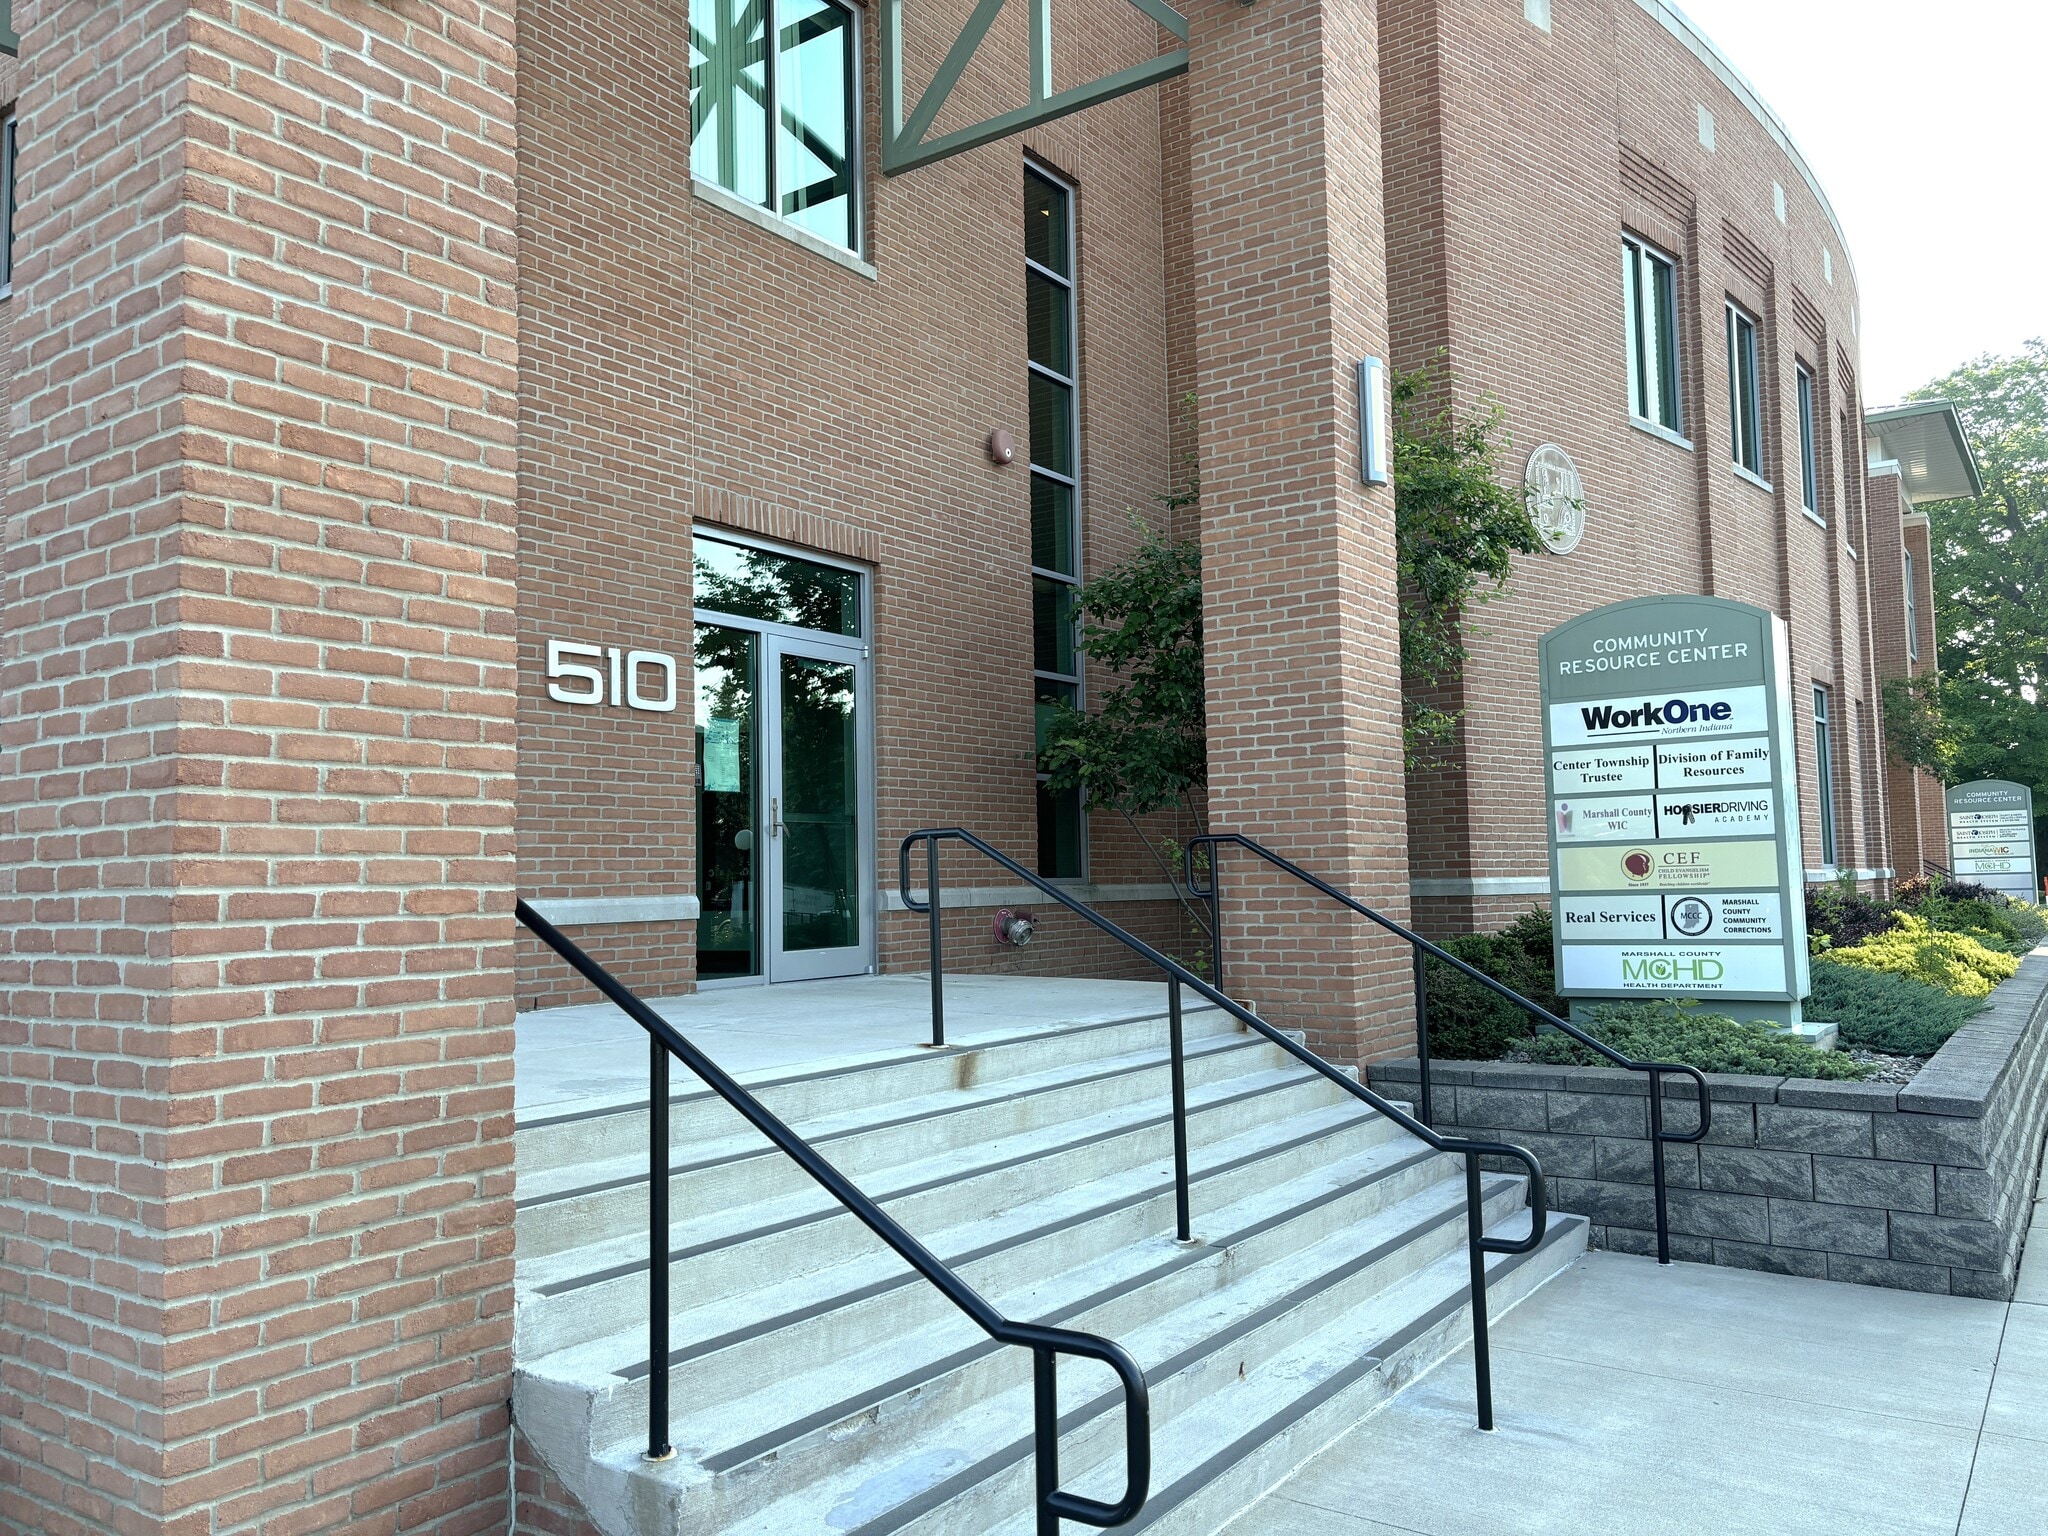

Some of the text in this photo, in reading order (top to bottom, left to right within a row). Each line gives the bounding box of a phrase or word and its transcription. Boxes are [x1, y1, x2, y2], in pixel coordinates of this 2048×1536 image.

[1593, 628, 1708, 653] COMMUNITY
[1560, 643, 1748, 675] RESOURCE CENTER
[545, 639, 677, 712] 510
[1581, 699, 1732, 730] WorkOne
[1661, 723, 1733, 735] Northern Indiana
[1658, 748, 1770, 765] Division of Family
[1553, 756, 1650, 771] Center Township
[1580, 773, 1623, 783] Trustee
[1683, 767, 1745, 778] Resources
[1582, 807, 1653, 819] Marshall County
[1714, 814, 1768, 823] ACADEMY
[1608, 821, 1628, 830] WIC
[1663, 852, 1700, 864] CEF
[1565, 910, 1656, 923] Real Services
[1680, 912, 1702, 920] MCCC
[1622, 958, 1724, 981] MCHD
